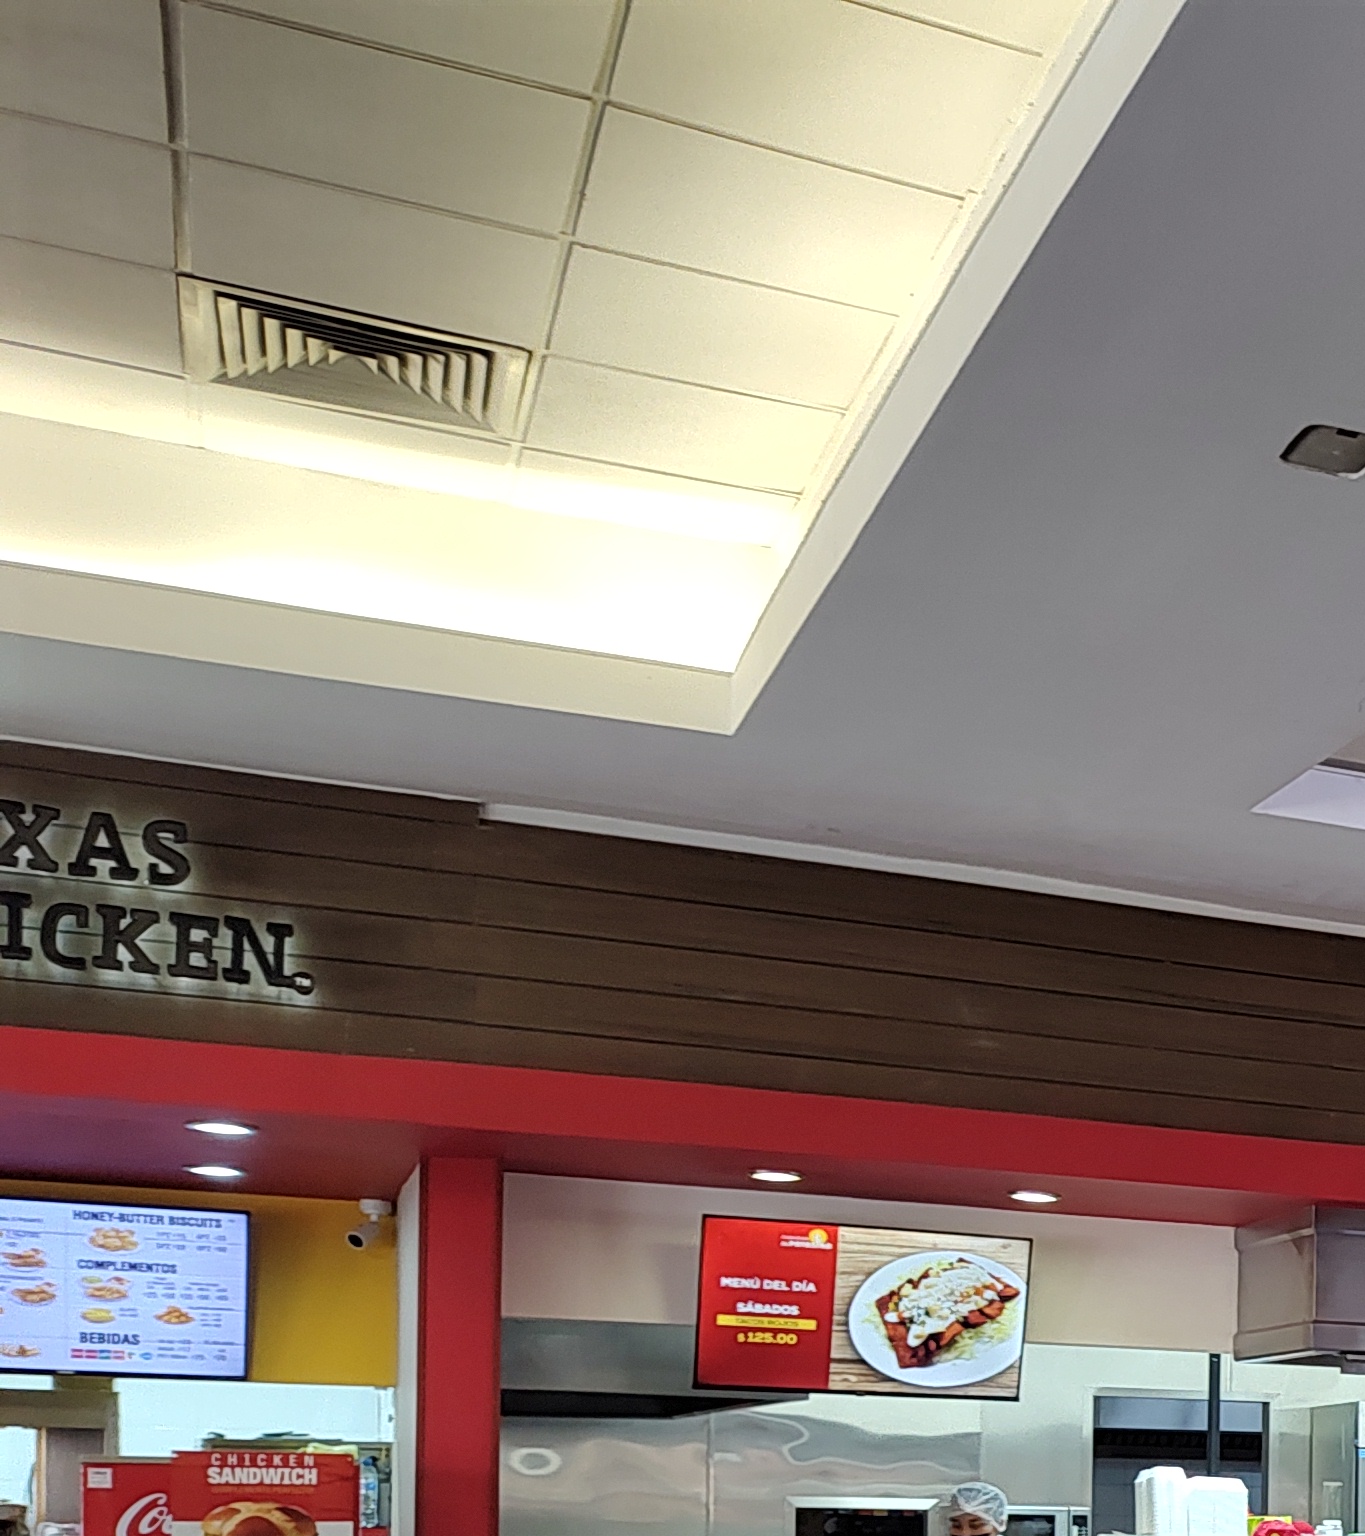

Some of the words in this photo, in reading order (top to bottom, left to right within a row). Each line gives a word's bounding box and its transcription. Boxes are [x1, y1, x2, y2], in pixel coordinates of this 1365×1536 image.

[77, 1259, 177, 1274] COMPLEMENTOS
[763, 1279, 790, 1291] DEL
[792, 1280, 817, 1293] DÍA
[80, 1332, 141, 1345] BEBIDAS
[211, 1453, 315, 1467] CHICKEN
[207, 1467, 318, 1485] SANDWICH
